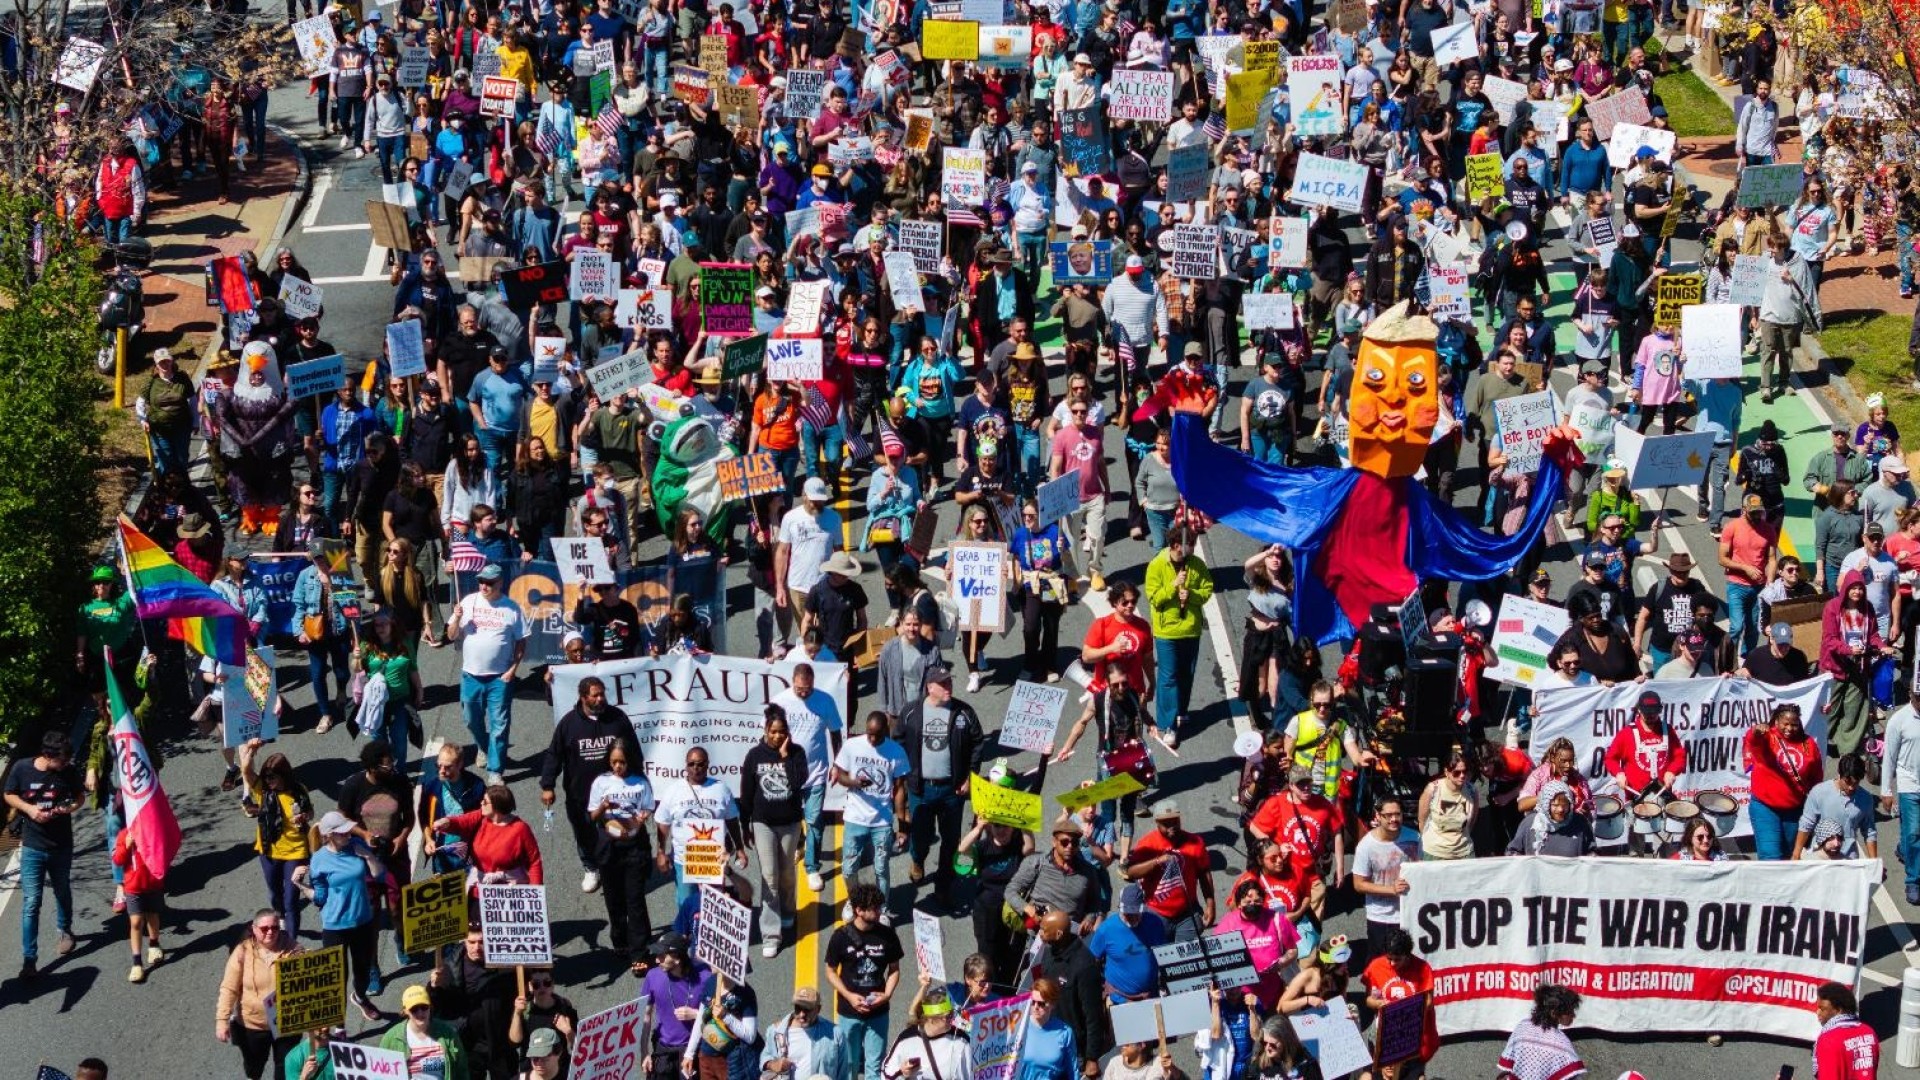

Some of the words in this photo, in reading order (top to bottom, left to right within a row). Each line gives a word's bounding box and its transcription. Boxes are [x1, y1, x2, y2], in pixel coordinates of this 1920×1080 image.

[1292, 59, 1338, 72] ABOLISH
[789, 72, 822, 85] DEFEND
[1116, 72, 1137, 82] THE
[1142, 72, 1168, 84] REAL
[485, 82, 513, 96] VOTE
[1112, 82, 1169, 97] ALIENS
[1117, 96, 1135, 105] ARE
[1139, 95, 1150, 105] IN
[1297, 120, 1336, 135] ICE
[1305, 157, 1364, 176] CHINGA
[1752, 165, 1804, 180] TRUMP
[1299, 180, 1359, 200] MIGRA
[821, 213, 845, 224] ICE
[901, 230, 926, 238] STAND
[928, 232, 939, 240] UP
[1178, 226, 1205, 234] MAY
[912, 239, 939, 248] TRUMP
[1177, 233, 1204, 242] STAND
[1177, 241, 1186, 249] TO
[1188, 242, 1215, 251] TRUMP
[1174, 252, 1213, 263] GENERAL
[520, 266, 544, 282] NO
[643, 262, 661, 272] ICE
[1173, 263, 1214, 277] STRIKE!
[703, 281, 725, 292] FOR
[1447, 276, 1466, 285] OUT
[1660, 277, 1699, 287] NO
[296, 284, 311, 295] NO
[541, 286, 564, 301] ICE
[581, 287, 604, 295] YOU!
[1659, 287, 1698, 300] KINGS
[709, 292, 744, 304] FUN
[637, 303, 656, 316] NO
[628, 314, 664, 326] KINGS
[769, 341, 803, 361] LOVE
[291, 369, 330, 385] Freedom
[202, 382, 222, 391] ICE
[308, 381, 336, 394] Press
[1503, 431, 1523, 446] BIG
[718, 461, 745, 483] BIG
[745, 453, 776, 479] LIES
[570, 543, 588, 560] ICE
[956, 551, 980, 562] GRAB
[963, 564, 975, 576] BY
[979, 565, 995, 576] THE
[262, 571, 296, 586] are
[958, 577, 998, 598] Votes
[610, 666, 791, 706] FRAUD
[1017, 684, 1065, 705] HISTORY
[1024, 701, 1045, 716] IS
[680, 717, 733, 731] RAGING
[1593, 708, 1626, 738] END
[578, 736, 616, 750] FRAUD
[640, 734, 687, 746] UNFAIR
[855, 756, 896, 770] FRAUD
[686, 864, 698, 875] NO
[699, 864, 722, 876] KINGS
[406, 875, 462, 908] ICE
[482, 887, 542, 899] CONGRESS:
[406, 895, 463, 918] OUT!
[484, 899, 505, 911] SAY
[509, 899, 525, 911] NO
[530, 900, 543, 911] TO
[704, 888, 736, 911] MAY
[485, 911, 544, 924] BILLIONS
[703, 898, 734, 923] STAND
[734, 916, 747, 932] UP
[486, 926, 503, 936] FOR
[505, 926, 545, 936] TRUMP'S
[702, 909, 713, 924] TO
[714, 914, 747, 942] TRUMP
[1417, 897, 1513, 955] STOP
[1523, 895, 1589, 948] THE
[1599, 898, 1689, 949] WAR
[1695, 902, 1751, 952] ON
[1757, 905, 1860, 967] IRAN!
[488, 944, 548, 954] IRAN
[700, 924, 744, 964] GENERAL
[280, 958, 301, 974] WE
[303, 951, 339, 970] DON'T
[698, 941, 744, 982] STRIKE!
[280, 967, 317, 981] WANT
[1165, 961, 1197, 978] PROTECT
[280, 971, 341, 996] EMPIRE!
[1433, 972, 1470, 997] ARTY
[1475, 970, 1505, 993] FOR
[1509, 967, 1589, 991] SOCIALISM
[1591, 972, 1603, 991] &
[1607, 971, 1695, 993] LIBERATION
[1725, 974, 1819, 1005] @PSLNATIO
[281, 988, 341, 1007] MONEY
[281, 1013, 305, 1026] NOT
[308, 1003, 342, 1020] WAR!
[616, 1002, 639, 1019] YOU
[976, 1008, 1023, 1043] STOP
[573, 1017, 640, 1068] SICK
[330, 1044, 368, 1071] NO
[594, 1055, 620, 1072] THESE
